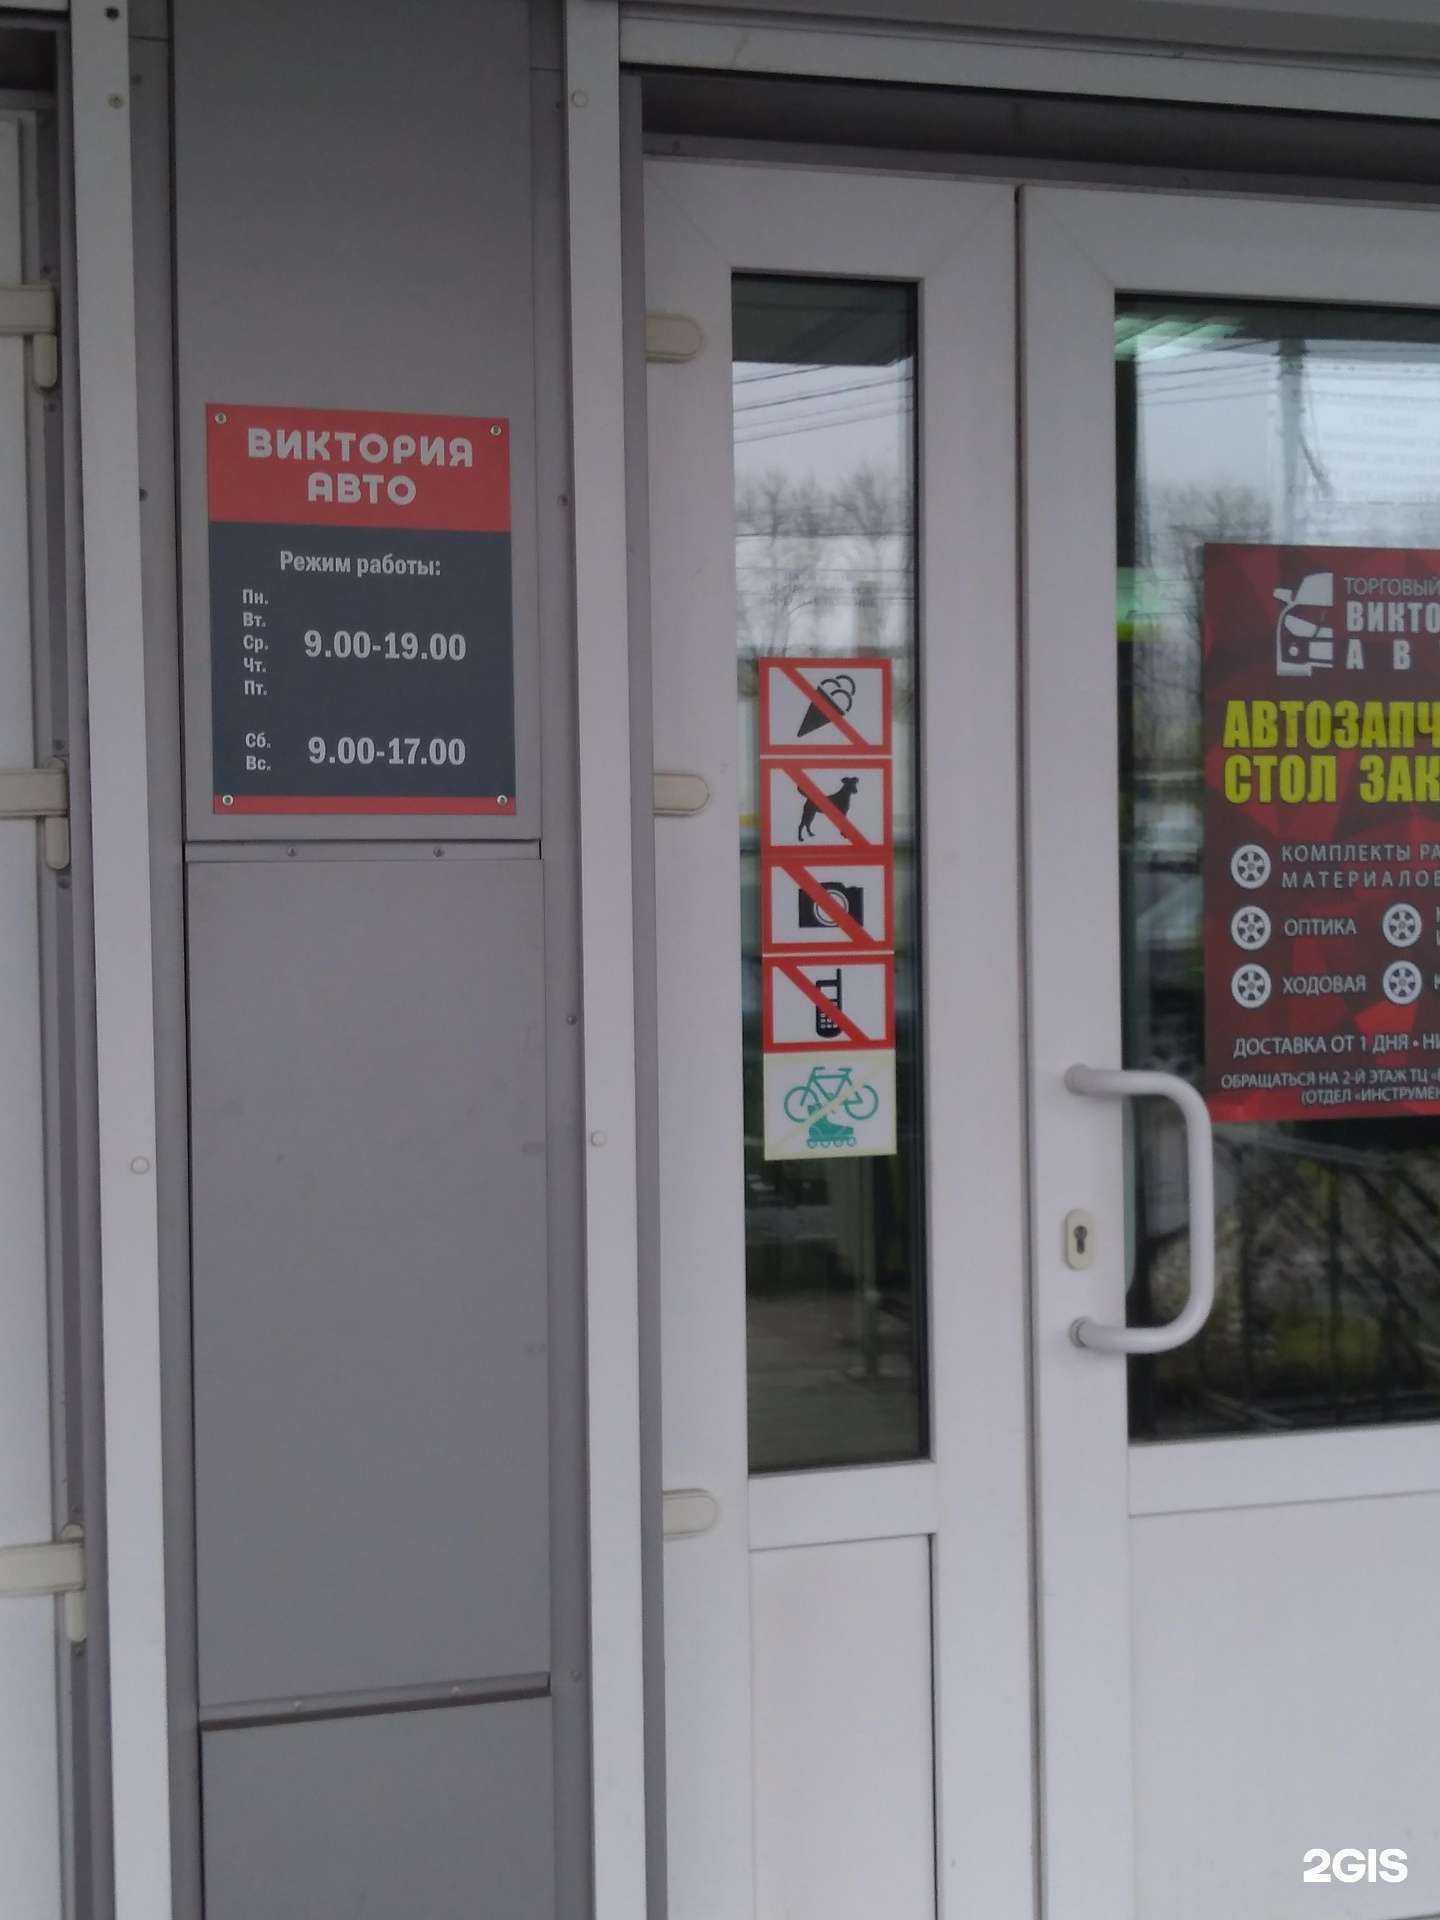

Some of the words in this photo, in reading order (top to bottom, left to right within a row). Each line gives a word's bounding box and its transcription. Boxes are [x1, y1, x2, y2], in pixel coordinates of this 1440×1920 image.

[248, 427, 473, 467] ВИКТОРИЯ
[308, 472, 417, 505] АВТО
[280, 551, 351, 574] Режим
[357, 554, 442, 578] работы:
[242, 588, 269, 604] Пн.
[1344, 576, 1440, 596] ТОРГОВЫЙ
[243, 612, 266, 627] Вт.
[1346, 601, 1440, 633] ВИКТО
[243, 634, 269, 652] Ср.
[304, 631, 467, 661] 9.00-19.00
[243, 657, 267, 672] Чт.
[244, 679, 268, 695] Пт.
[1223, 700, 1440, 748] АВТОЗАПЧ
[245, 732, 271, 748] Сб.
[308, 736, 467, 765] 9.00-17.00
[246, 755, 271, 771] Вс.
[1224, 755, 1337, 803] СТОЛ
[1360, 755, 1440, 803] ЗАК
[1281, 844, 1410, 862] КОМПЛЕКТЫ
[1284, 918, 1357, 937] ОПТИКА
[1283, 975, 1366, 996] ХОДОВАЯ
[1233, 1036, 1327, 1059] ДОСТАВКА
[1331, 1034, 1355, 1053] ОТ
[1360, 1036, 1366, 1051] 1
[1372, 1033, 1409, 1054] ДНЯ
[1221, 1071, 1315, 1090] ОБРАЩАТЬСЯ
[1318, 1071, 1338, 1085] НА
[1369, 1069, 1407, 1084] ЭТАЖ
[1410, 1068, 1428, 1084] ТЦ
[1301, 1088, 1352, 1106] (ОТДЕЛ
